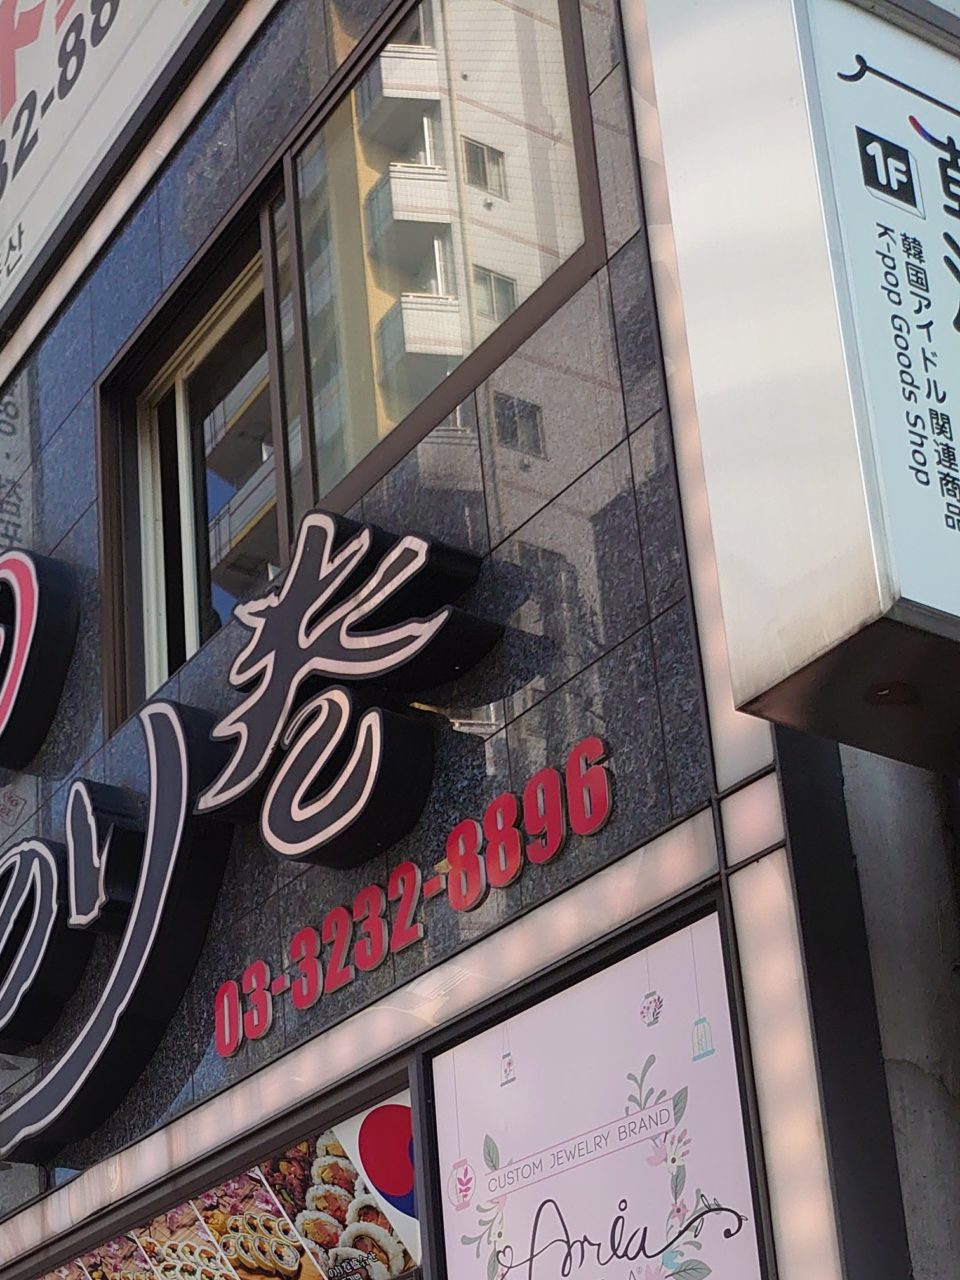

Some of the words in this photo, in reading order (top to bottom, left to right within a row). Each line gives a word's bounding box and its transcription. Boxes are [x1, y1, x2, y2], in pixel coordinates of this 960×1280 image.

[866, 141, 908, 191] 1F
[875, 221, 903, 309] K-pop
[891, 312, 919, 404] Goods
[906, 405, 931, 487] Shop
[214, 736, 613, 1059] 03-3232-8896
[487, 1157, 544, 1194] CUSTOM
[549, 1131, 610, 1171] JEWELRY
[617, 1105, 672, 1147] BRAND
